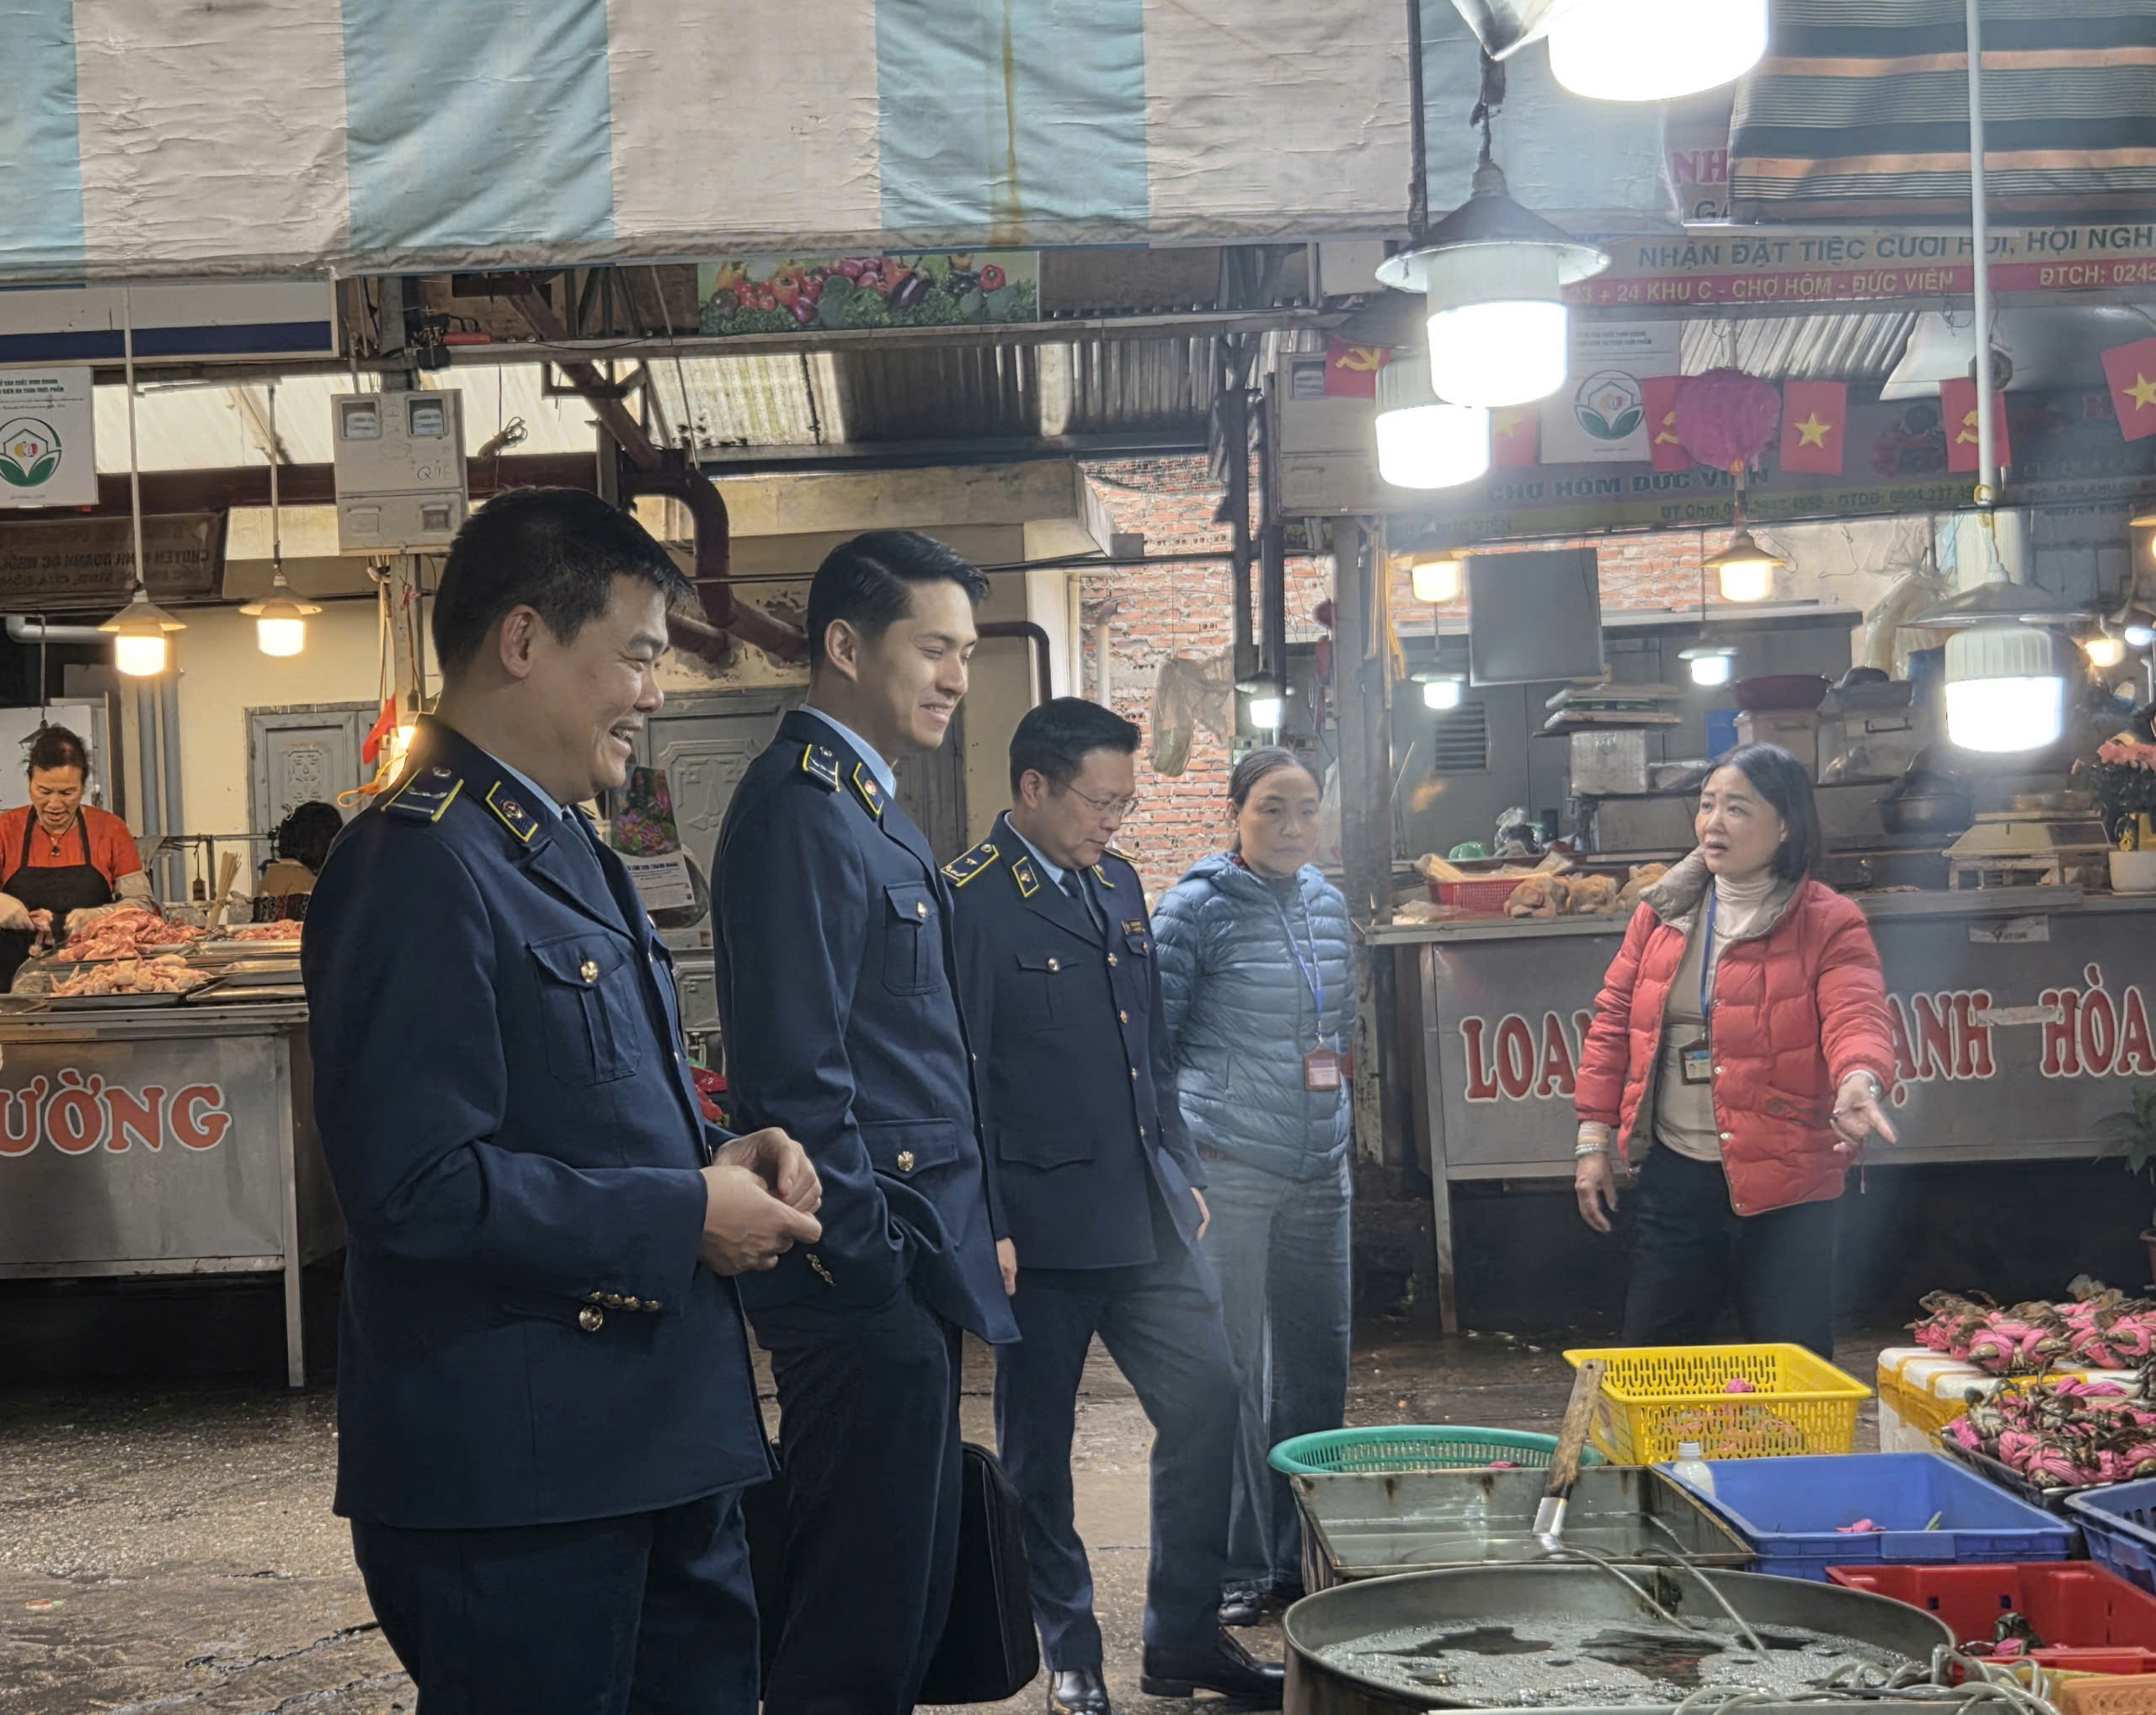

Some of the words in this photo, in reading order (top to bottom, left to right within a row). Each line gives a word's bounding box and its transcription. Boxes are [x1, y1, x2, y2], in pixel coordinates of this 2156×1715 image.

[1639, 242, 1719, 270] NHẬN
[1730, 237, 1789, 267] ĐẶT
[1799, 237, 1865, 265] TIỆC
[2089, 227, 2156, 249] NGH
[1617, 285, 1638, 302] 24
[1647, 283, 1691, 301] KHU
[1698, 281, 1712, 299] C
[1732, 275, 1779, 299] CHỢ
[1785, 272, 1831, 295] HÔM
[1853, 270, 1897, 292] ĐỨC
[1905, 268, 1953, 291] VIÊN
[1699, 465, 1769, 489] VIN
[2038, 963, 2156, 1078] HÒA
